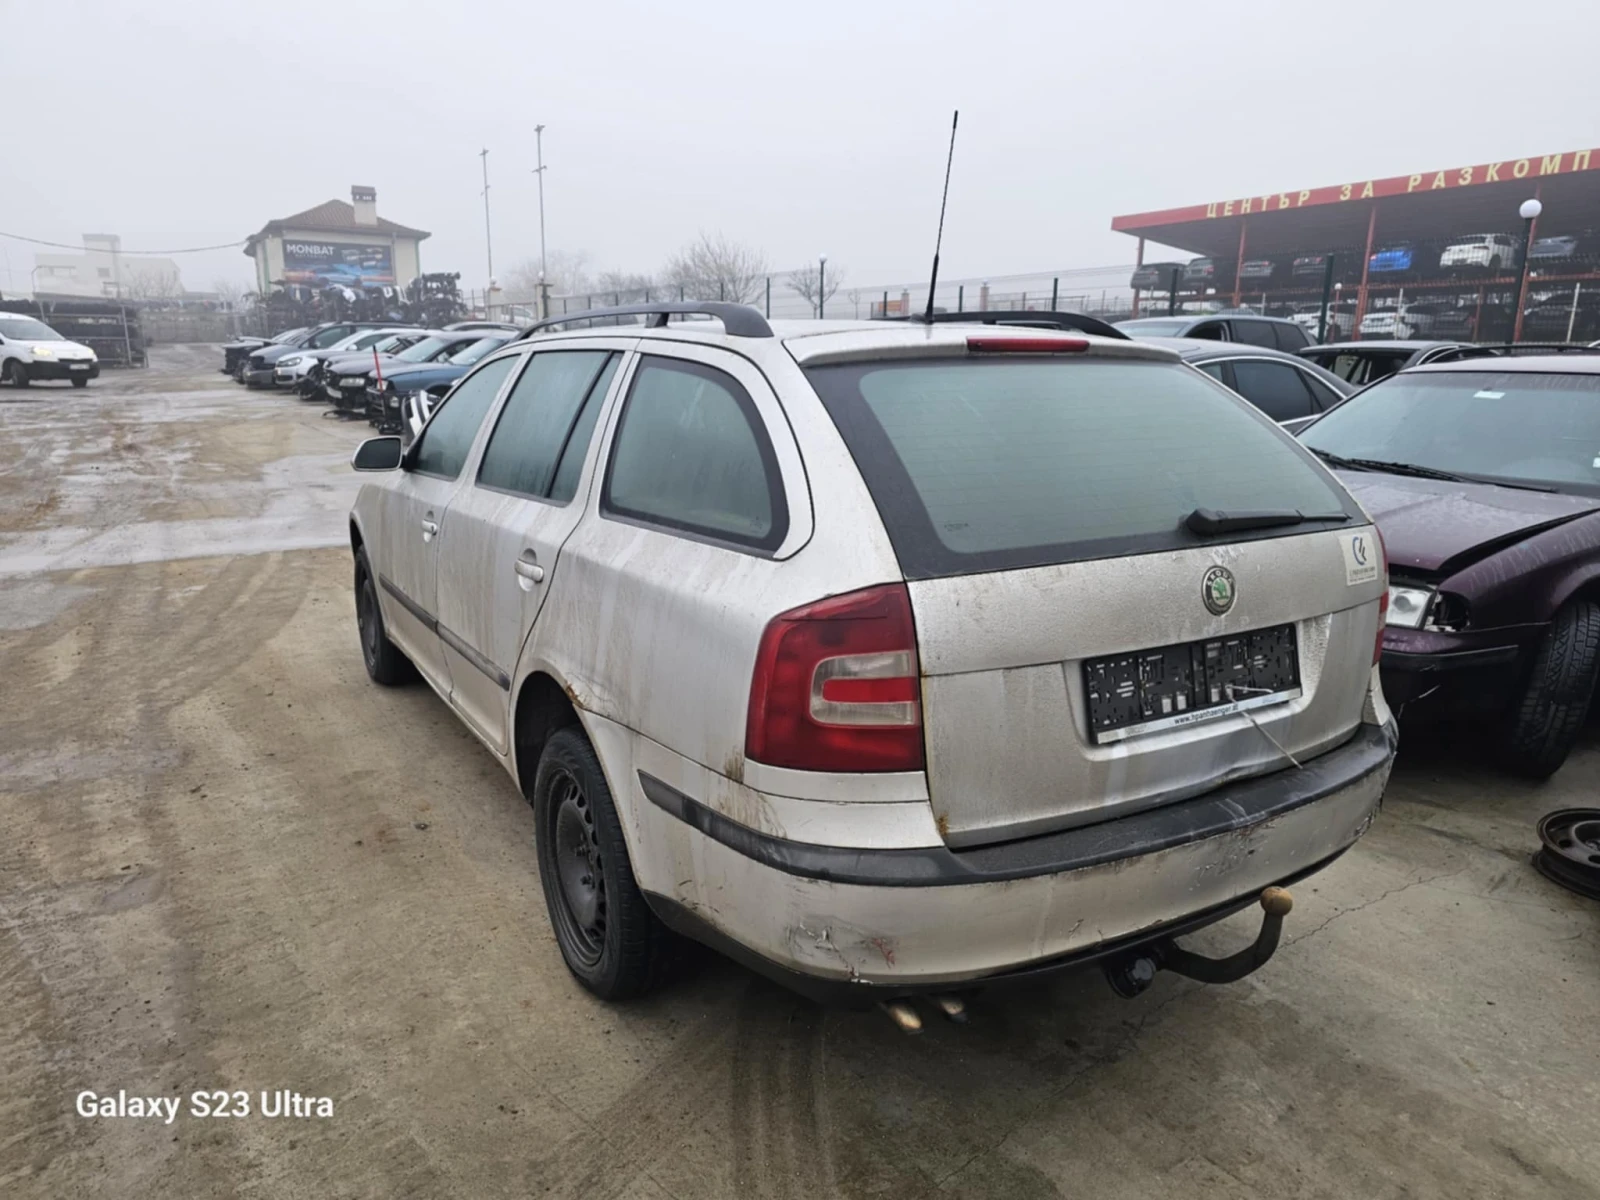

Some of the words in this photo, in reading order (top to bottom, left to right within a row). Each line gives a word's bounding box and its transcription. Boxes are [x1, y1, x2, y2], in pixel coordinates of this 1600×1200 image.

[1207, 190, 1310, 218] ЦЕНТЪР
[1339, 181, 1374, 201] ЗА
[1407, 150, 1592, 193] РАЗКОМП
[286, 243, 335, 255] MONBAT
